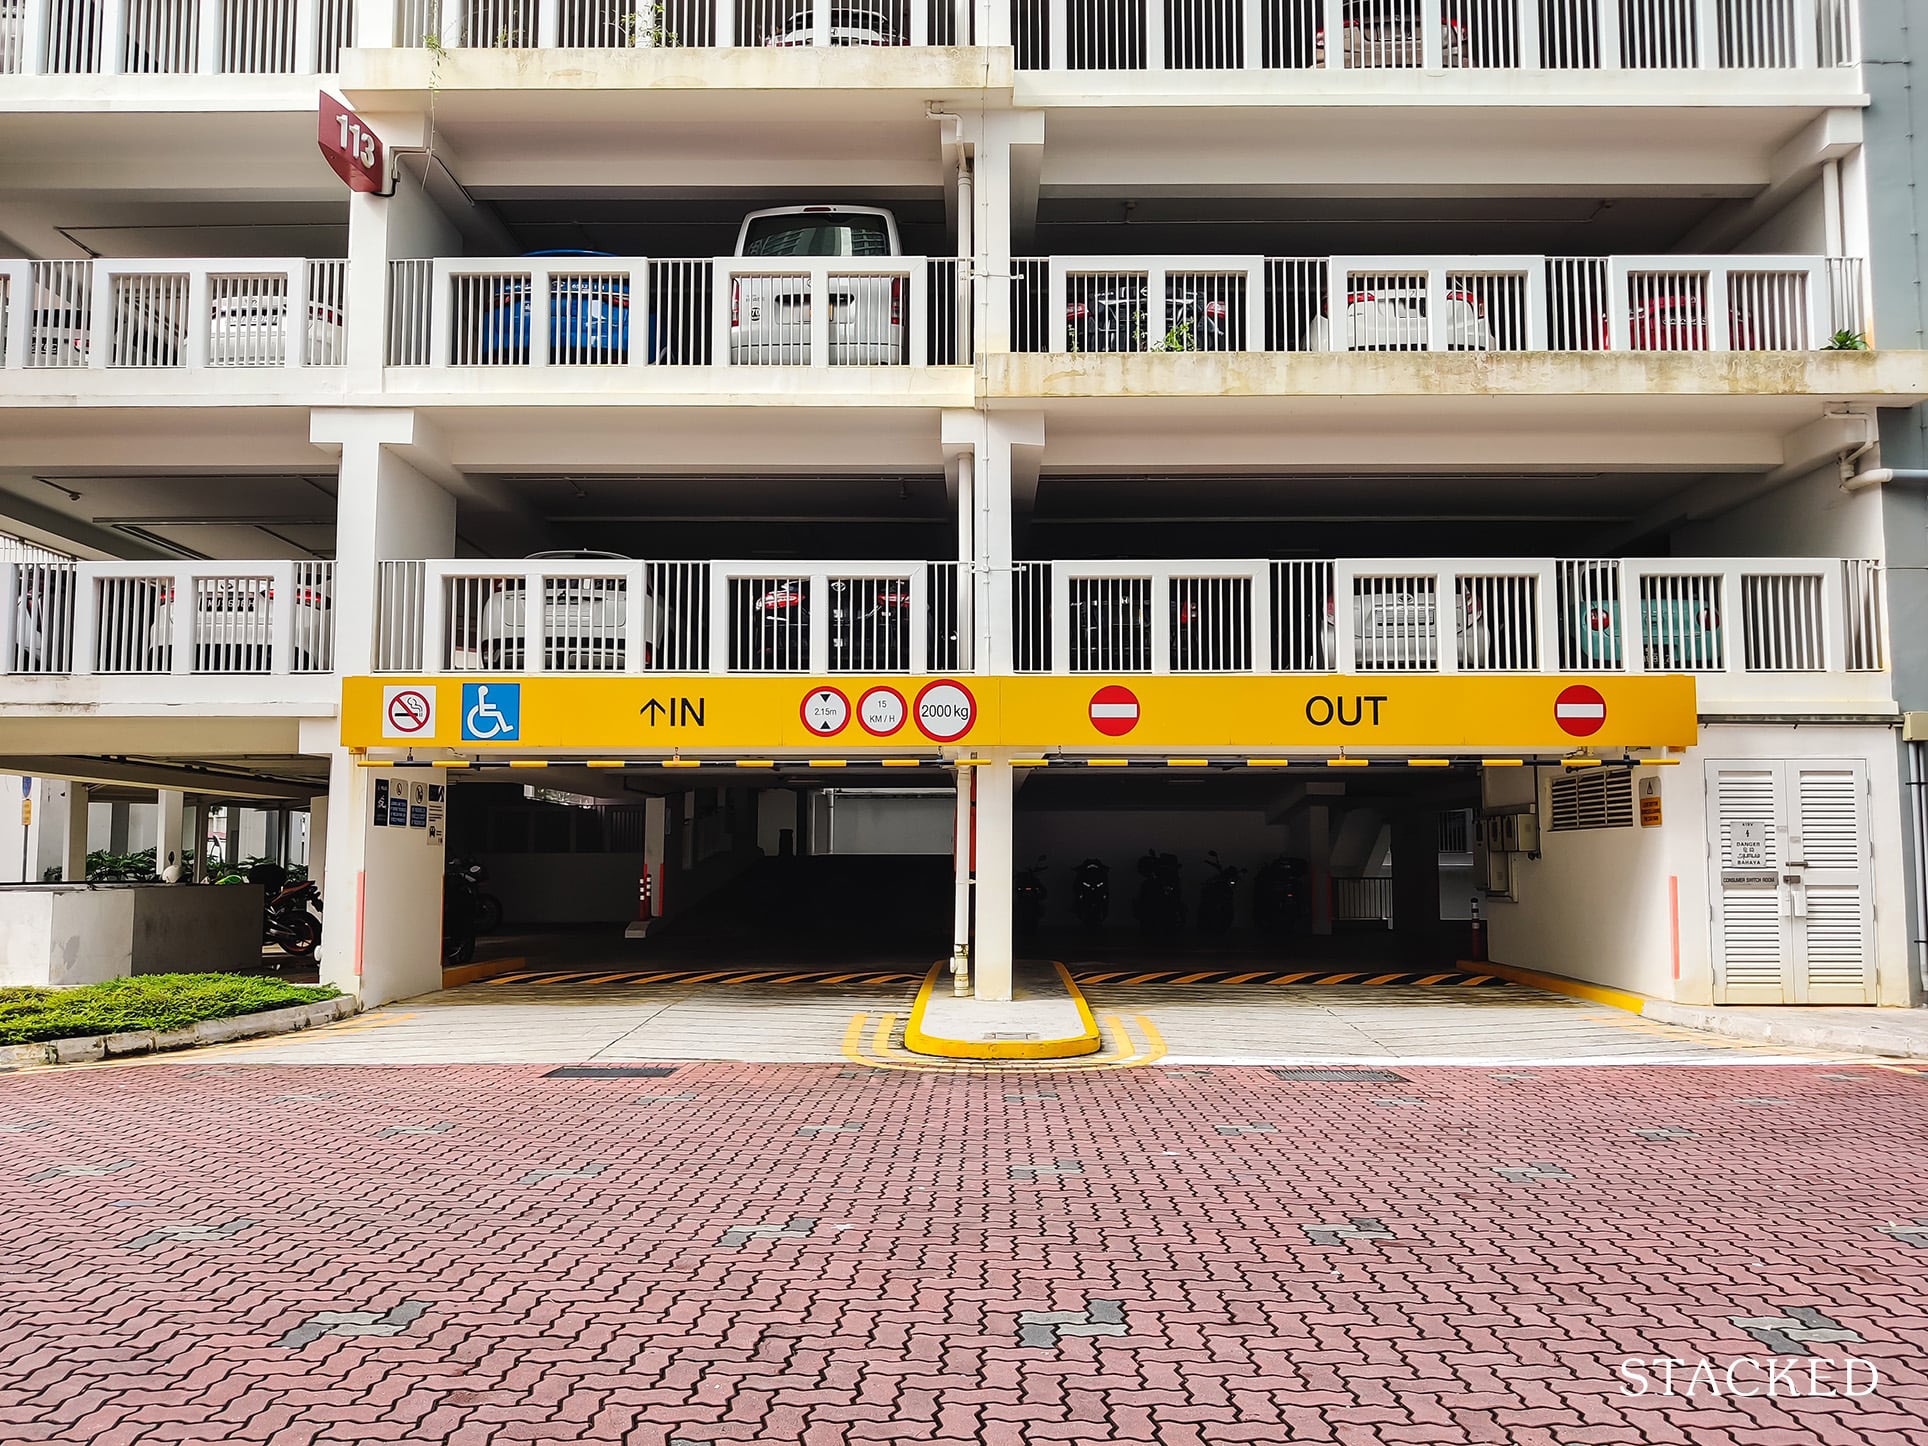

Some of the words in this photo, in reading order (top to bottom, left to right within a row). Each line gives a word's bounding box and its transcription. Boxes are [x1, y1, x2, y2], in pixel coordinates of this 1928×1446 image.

[336, 114, 375, 168] 113
[877, 700, 887, 708] 15
[1305, 695, 1387, 726] OUT
[670, 698, 704, 726] IN
[814, 708, 837, 716] 2.15m
[869, 715, 883, 723] KM
[921, 705, 951, 718] 2000
[953, 705, 969, 720] kg
